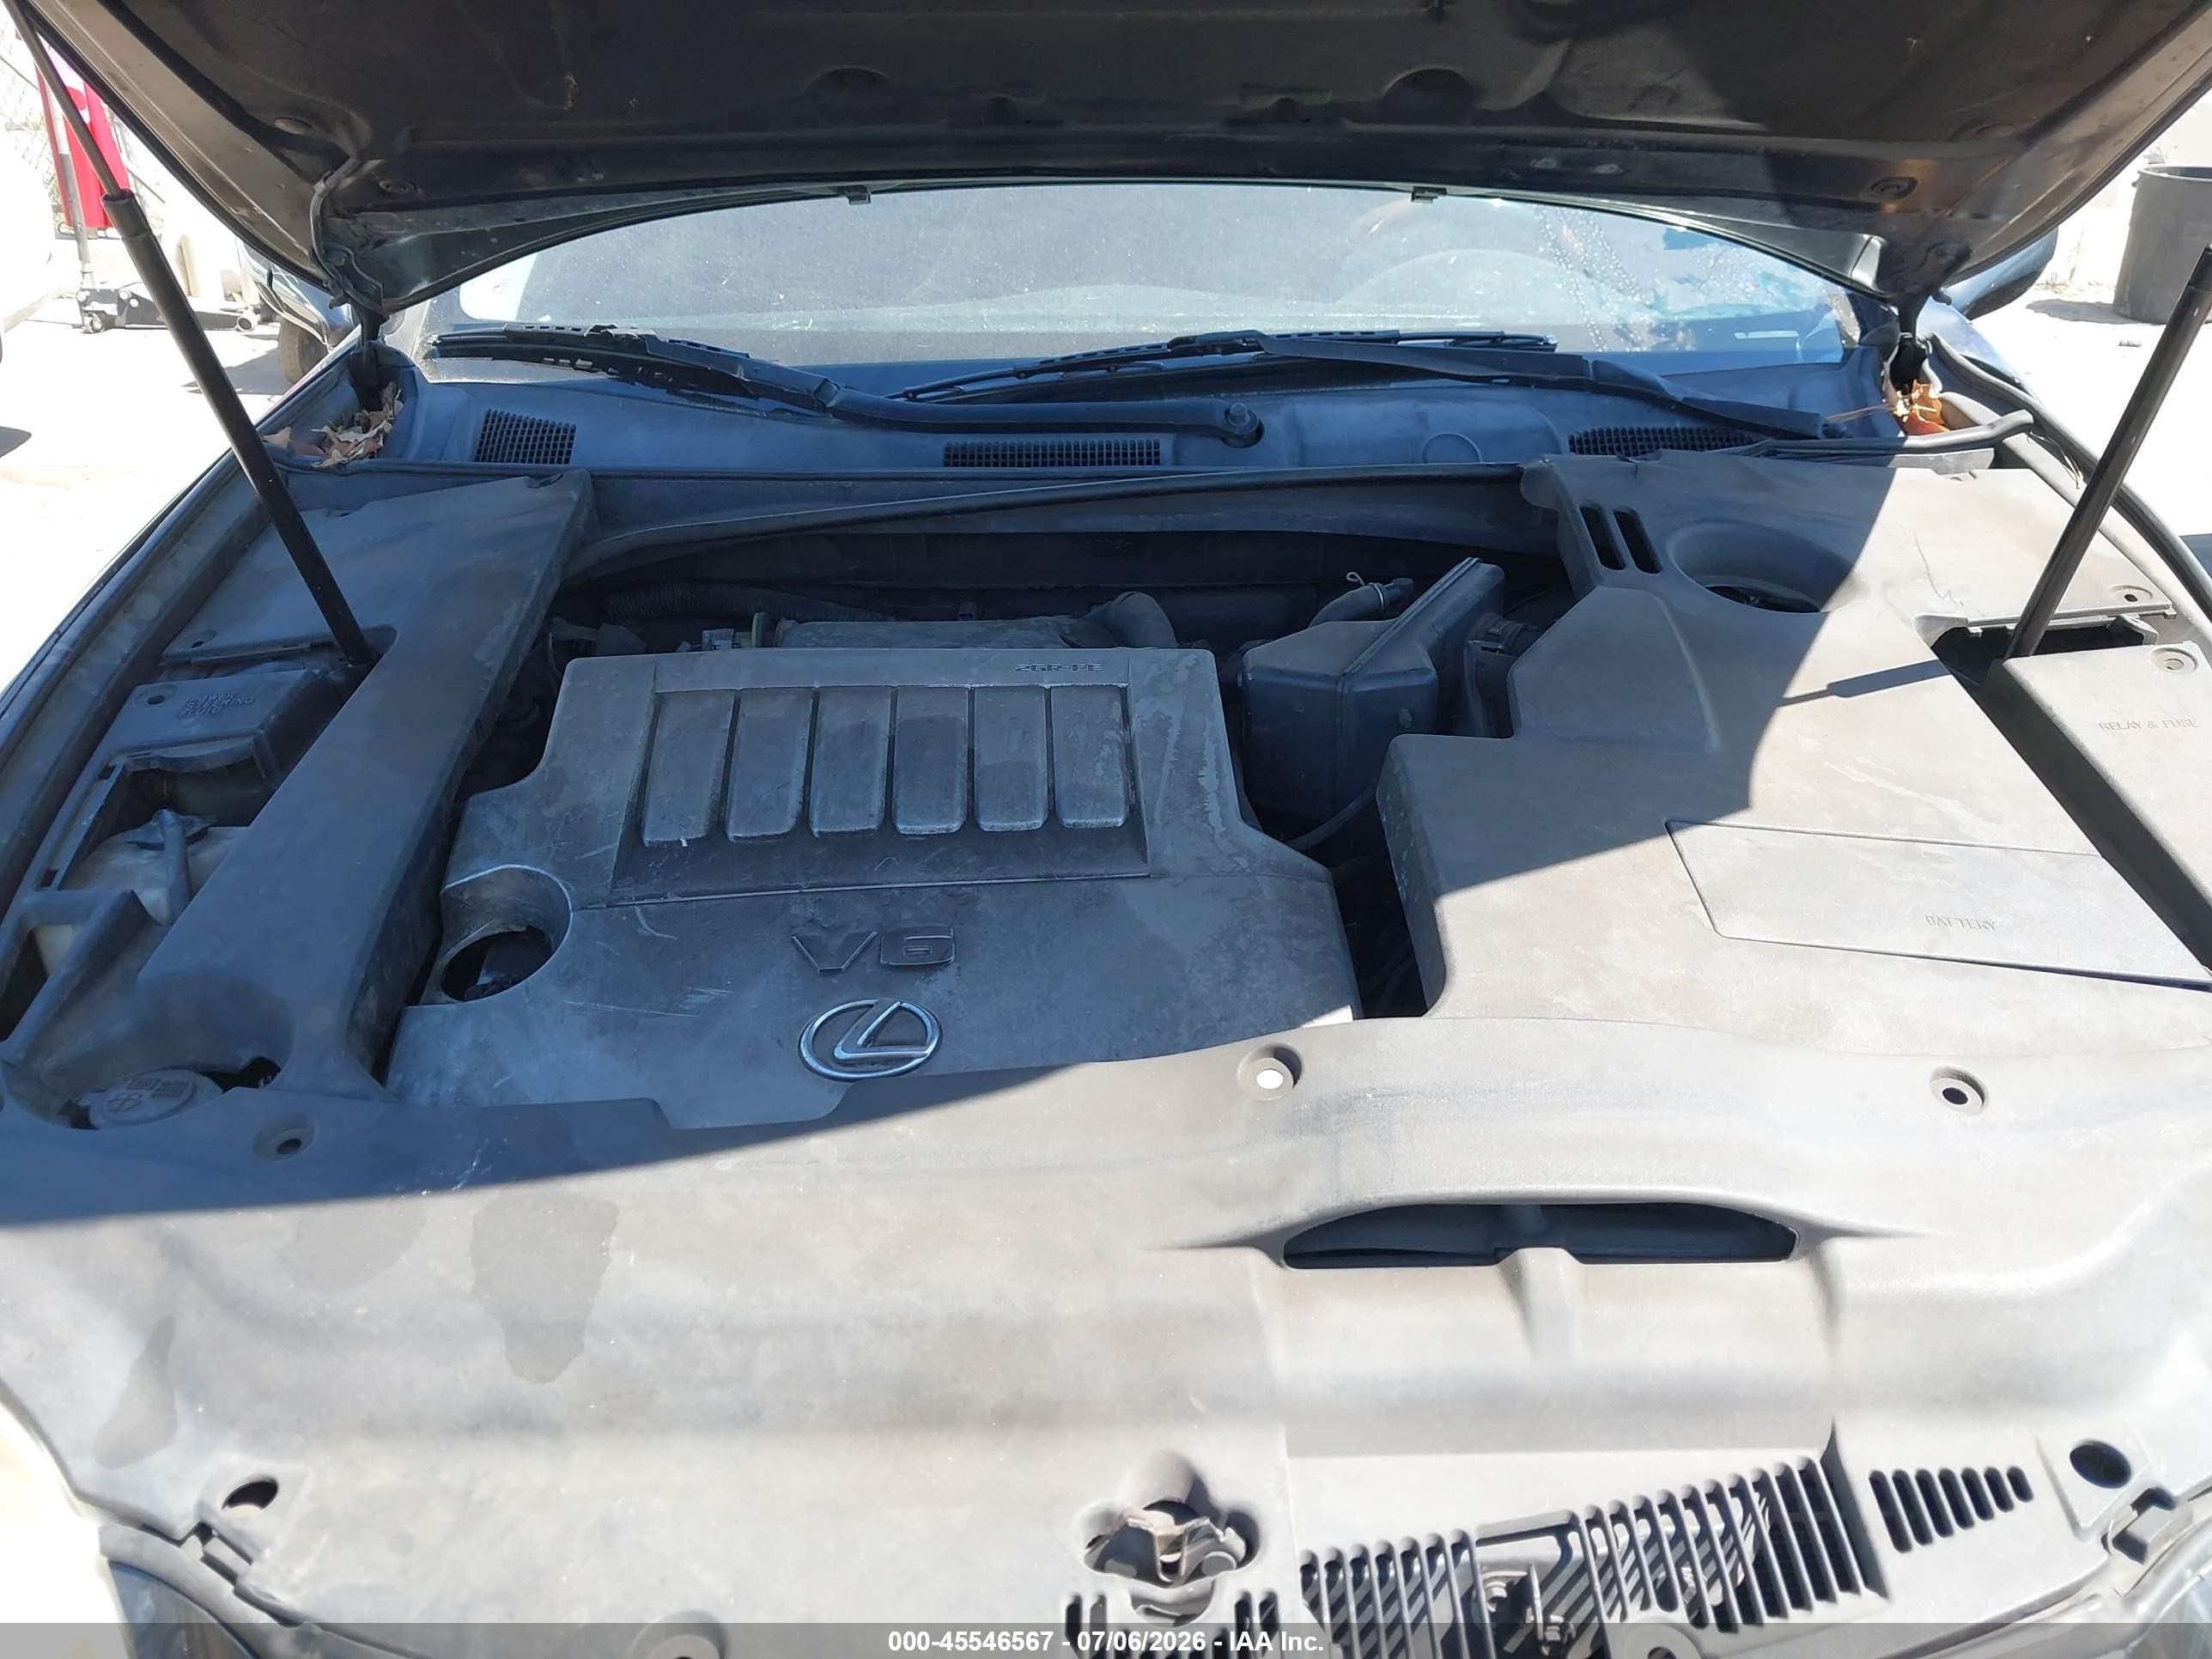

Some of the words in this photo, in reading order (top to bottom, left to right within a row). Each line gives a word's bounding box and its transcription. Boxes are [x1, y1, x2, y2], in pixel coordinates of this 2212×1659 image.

[2098, 720, 2142, 731] RELAY
[2146, 720, 2159, 729] &
[2161, 719, 2199, 729] FUSE
[1924, 915, 1996, 932] BATTERY
[791, 927, 956, 975] V6
